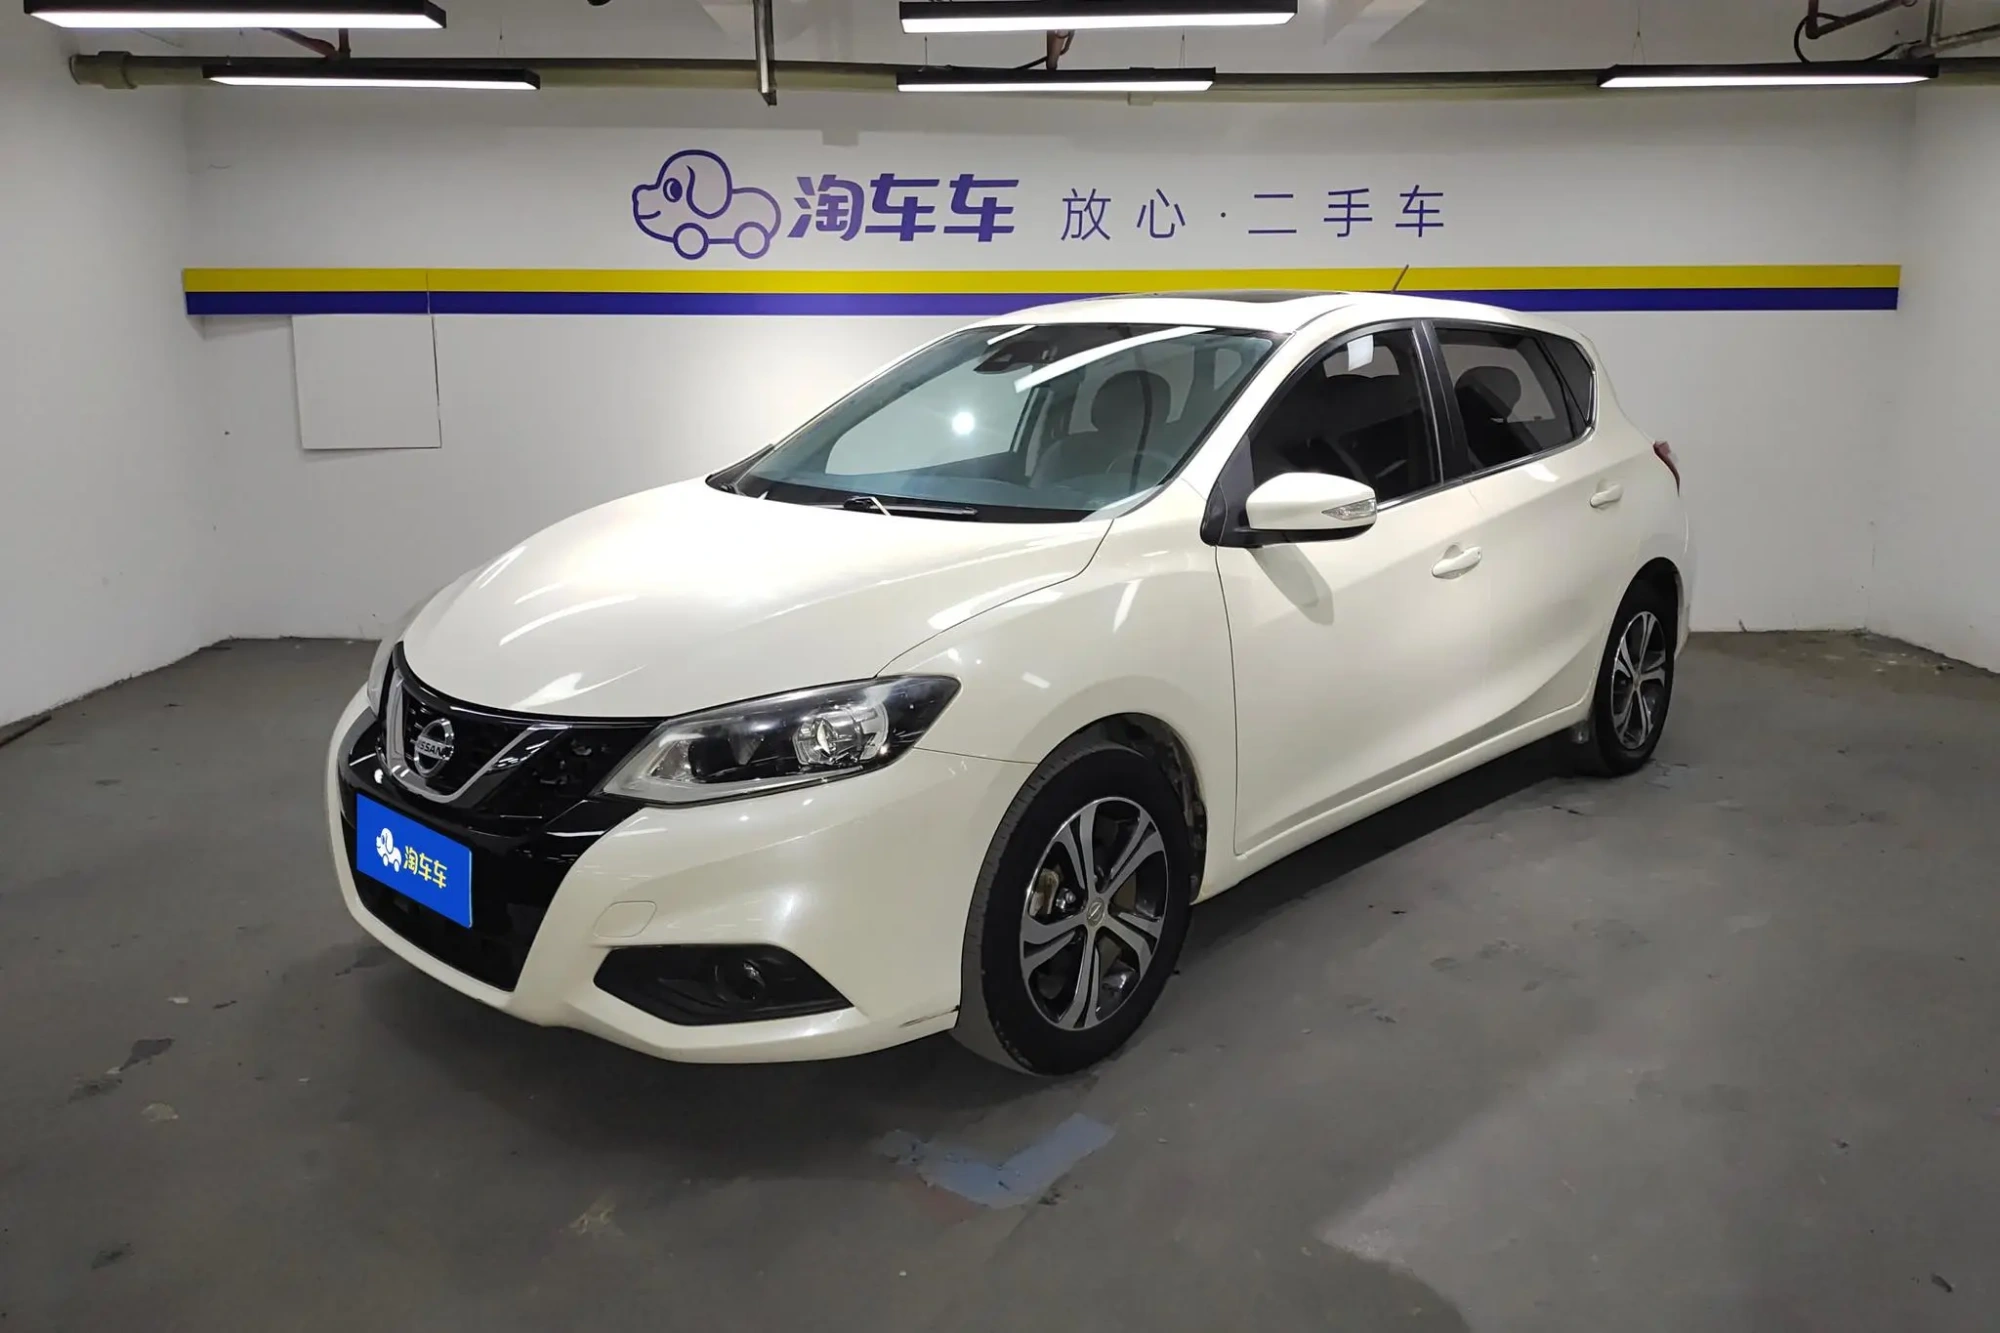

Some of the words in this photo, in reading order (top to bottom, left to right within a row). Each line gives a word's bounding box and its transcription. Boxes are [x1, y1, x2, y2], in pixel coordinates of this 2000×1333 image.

[788, 173, 1019, 243] 淘车车
[416, 739, 444, 758] ISSAN
[403, 846, 448, 889] 淘车车
